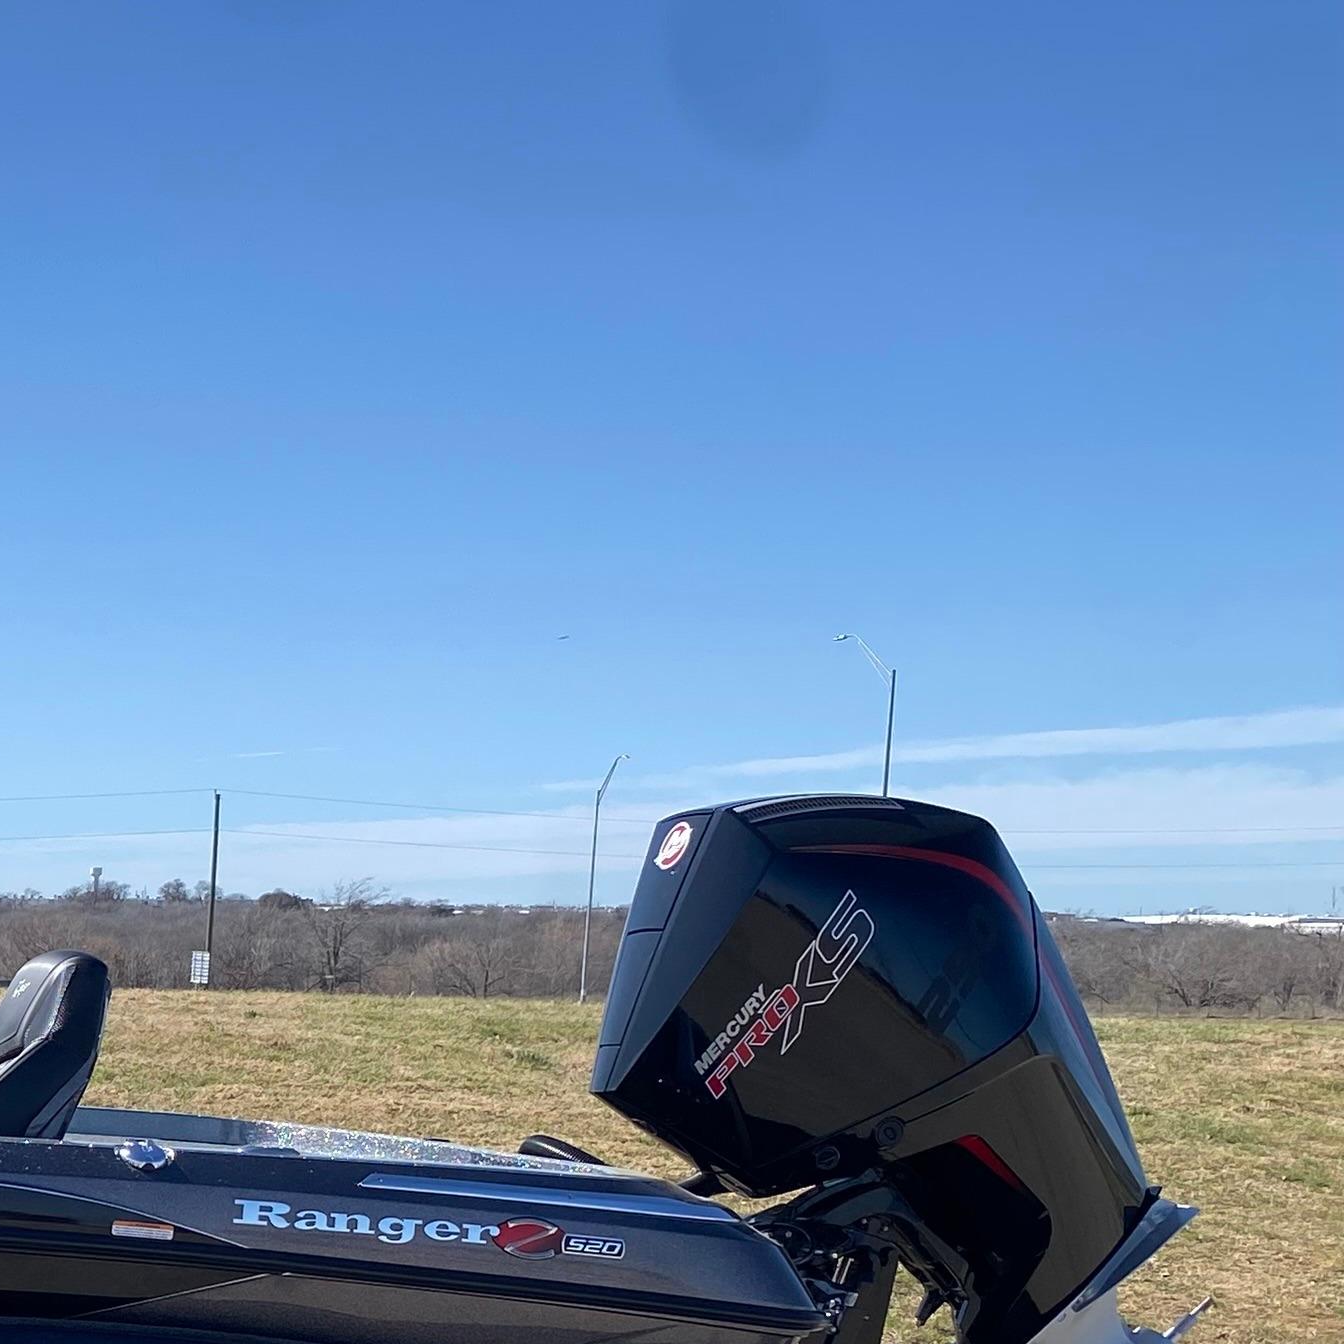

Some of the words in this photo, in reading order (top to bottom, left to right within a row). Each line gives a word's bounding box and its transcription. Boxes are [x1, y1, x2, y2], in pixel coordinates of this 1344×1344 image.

[694, 983, 767, 1075] MERCURY
[232, 1199, 501, 1245] Ranger
[566, 1239, 622, 1255] 520
